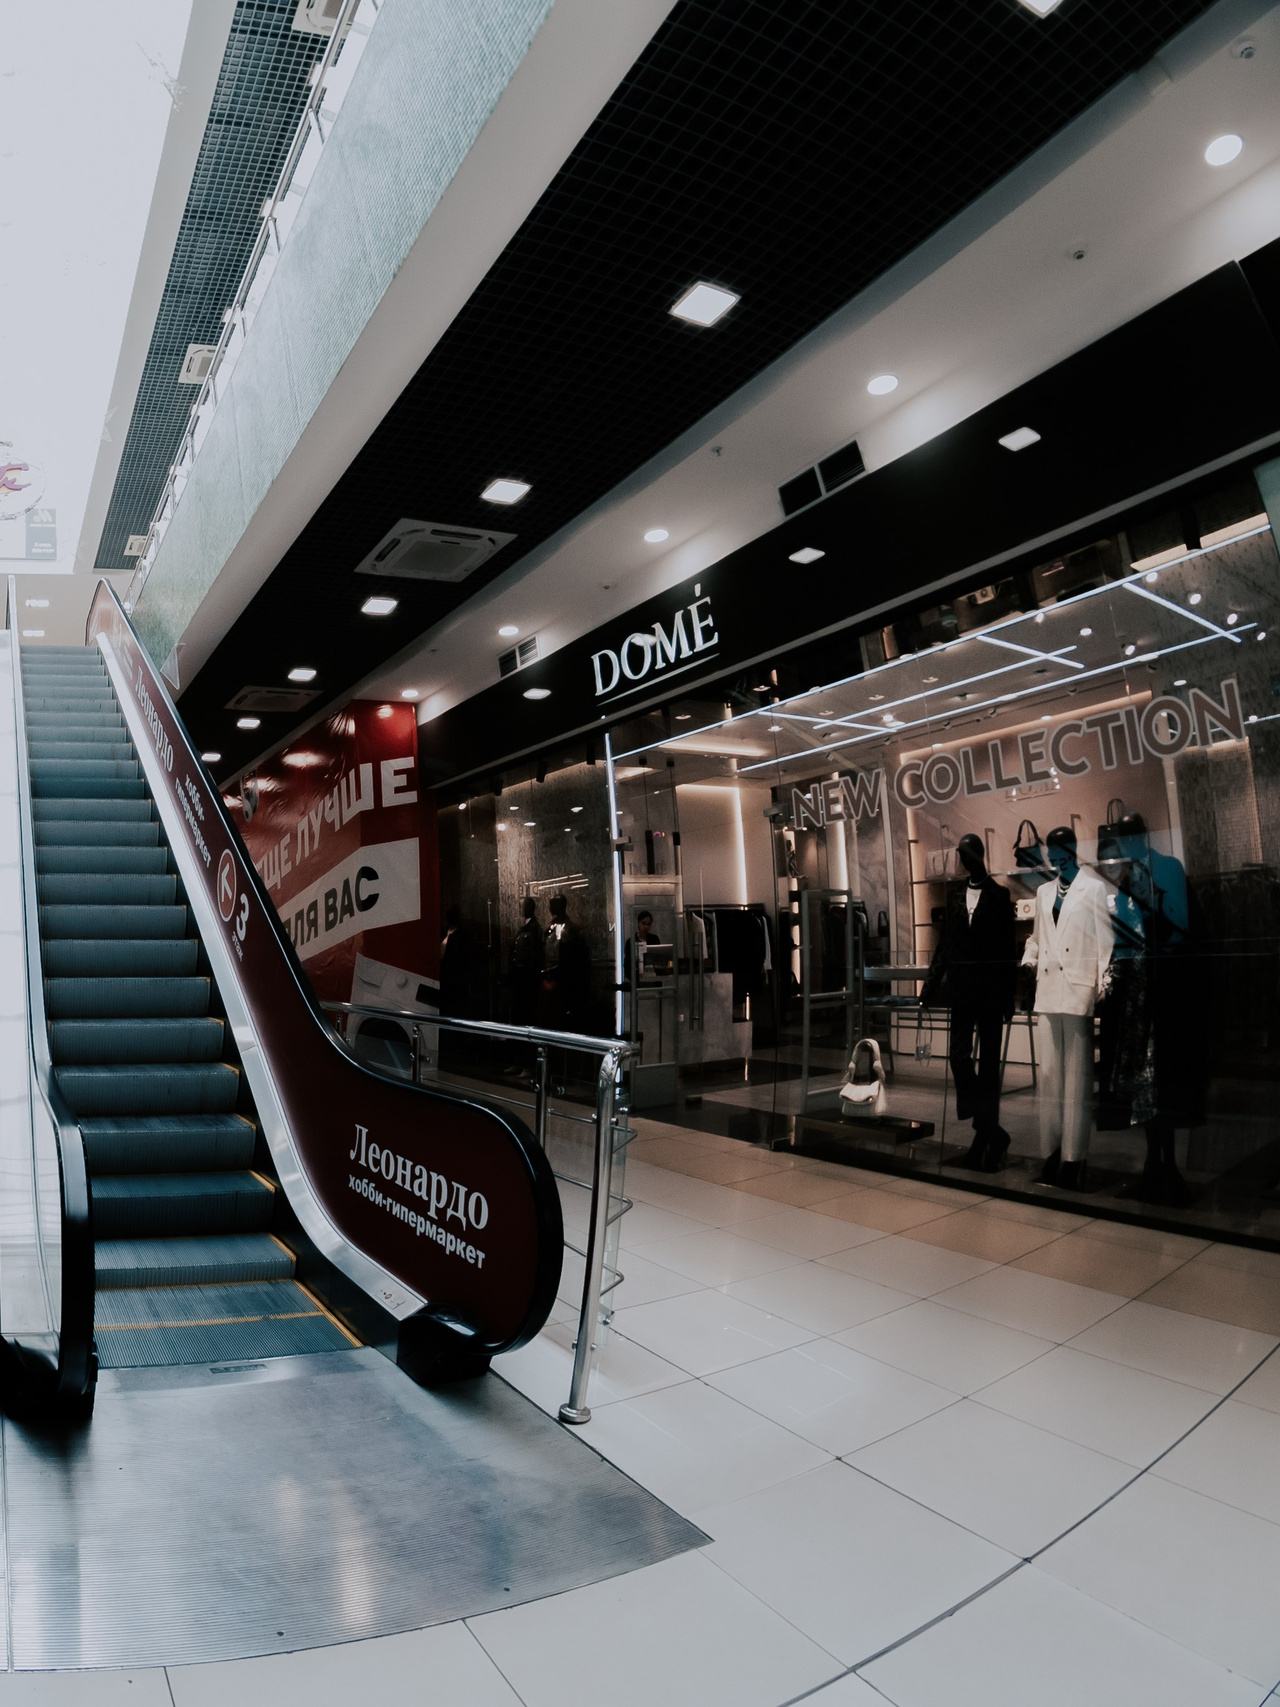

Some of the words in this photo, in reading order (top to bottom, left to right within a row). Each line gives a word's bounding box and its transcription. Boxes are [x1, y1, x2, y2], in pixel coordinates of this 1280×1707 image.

[591, 583, 719, 696] DOMÉ
[135, 665, 174, 773] Леонардо
[792, 769, 883, 829] NEW
[894, 678, 1246, 808] COLLECTION
[175, 777, 212, 868] гипермаркет
[185, 774, 205, 822] хобби-
[295, 756, 418, 866] ЛУЧШЕ
[236, 893, 249, 941] 3
[324, 866, 380, 933] ВАС
[348, 1174, 486, 1269] хобби-гипермаркет
[350, 1123, 489, 1231] Леонардо
